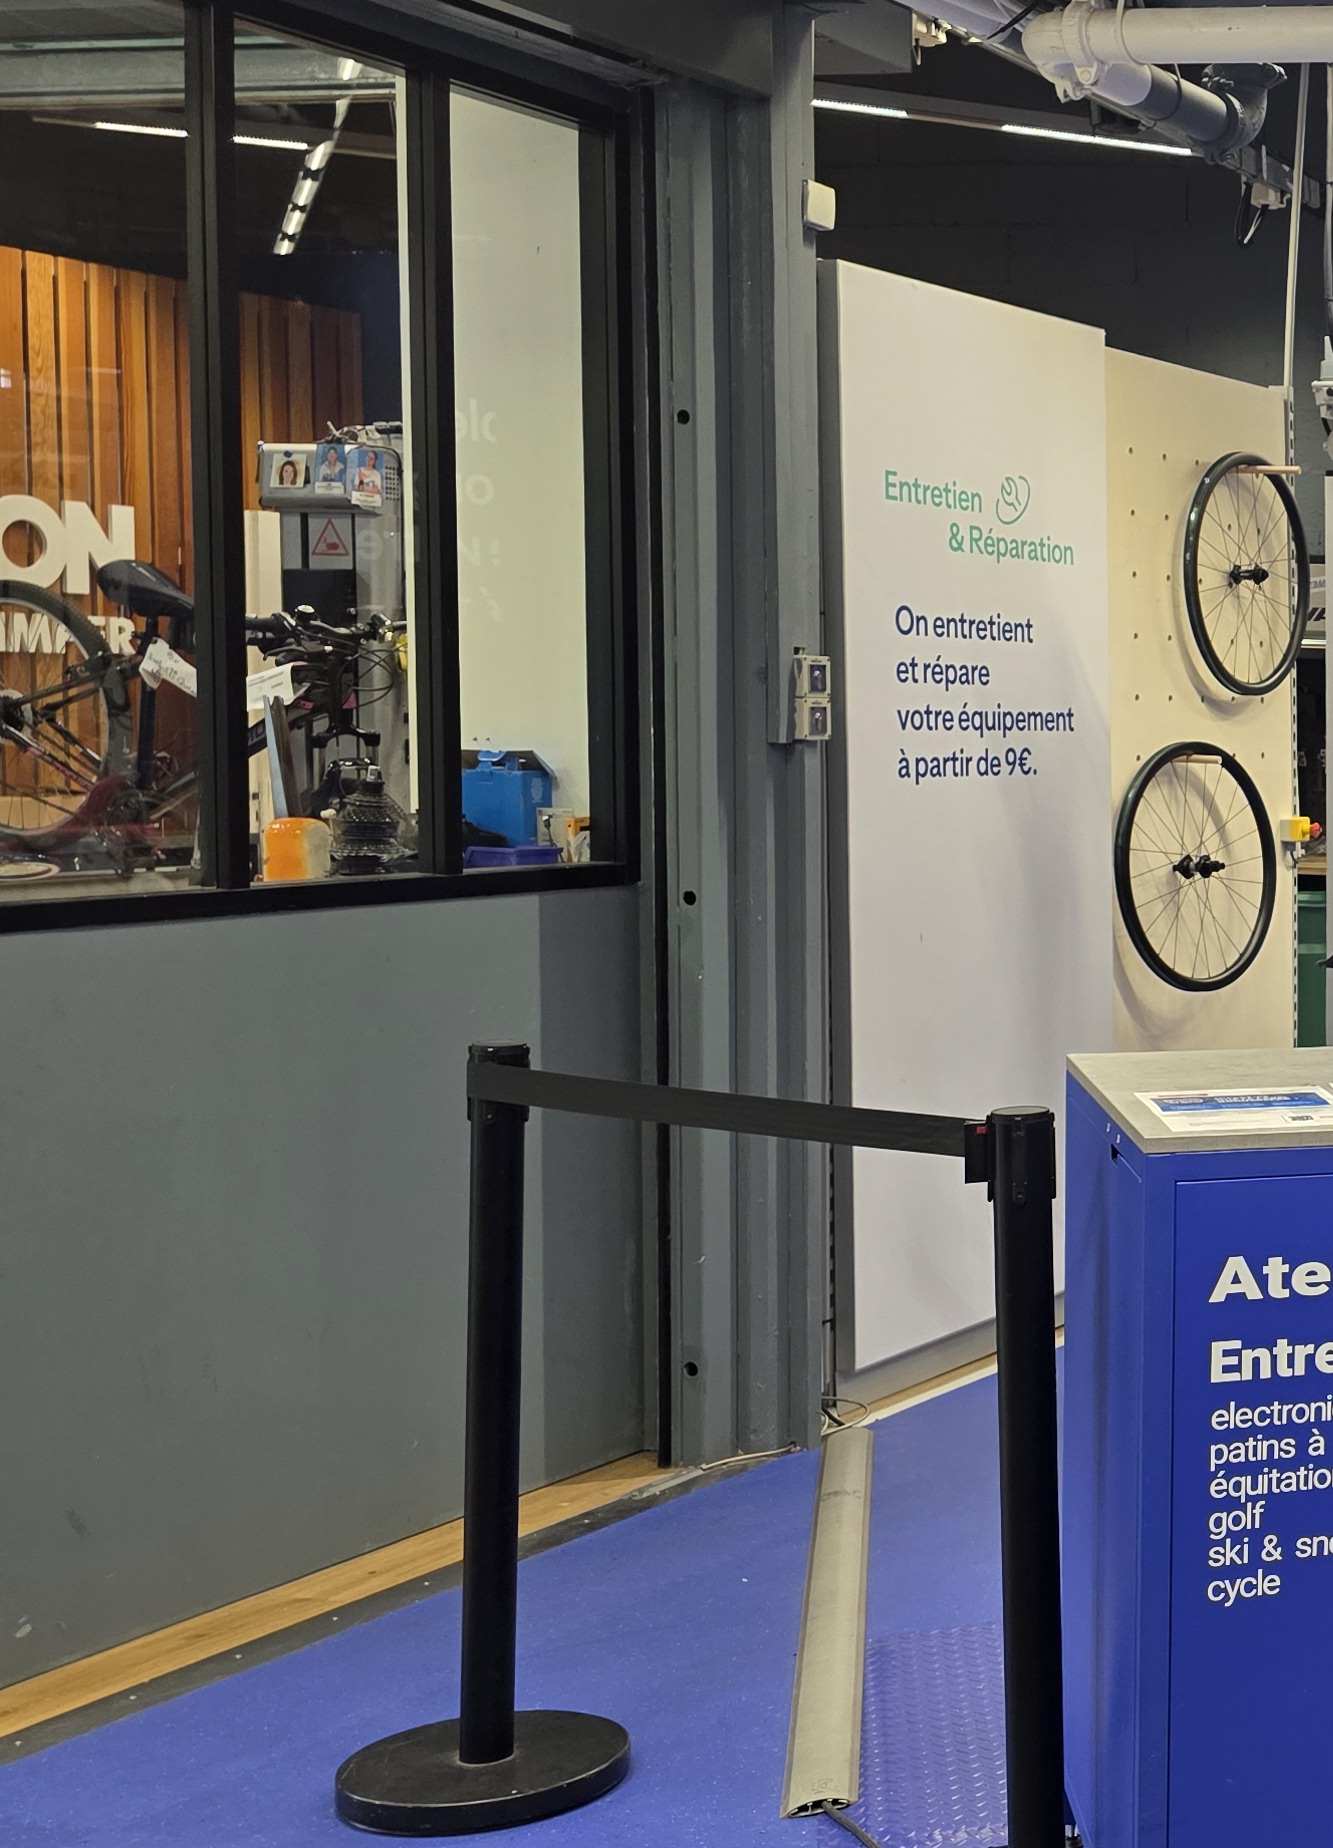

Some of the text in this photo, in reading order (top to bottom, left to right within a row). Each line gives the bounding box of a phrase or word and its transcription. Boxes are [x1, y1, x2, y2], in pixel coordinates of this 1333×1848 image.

[885, 470, 982, 513] Entretien
[949, 523, 1074, 565] & Réparation
[895, 605, 1033, 643] On entretient
[897, 656, 990, 691] et répare
[897, 702, 1074, 738] votre équipement
[898, 747, 1037, 785] à partir de 9€.
[1210, 1434, 1295, 1472] patins
[1308, 1429, 1324, 1458] à
[1208, 1501, 1265, 1540] golf
[1207, 1537, 1249, 1567] ski
[1261, 1534, 1283, 1562] &
[1207, 1569, 1281, 1607] cycle
